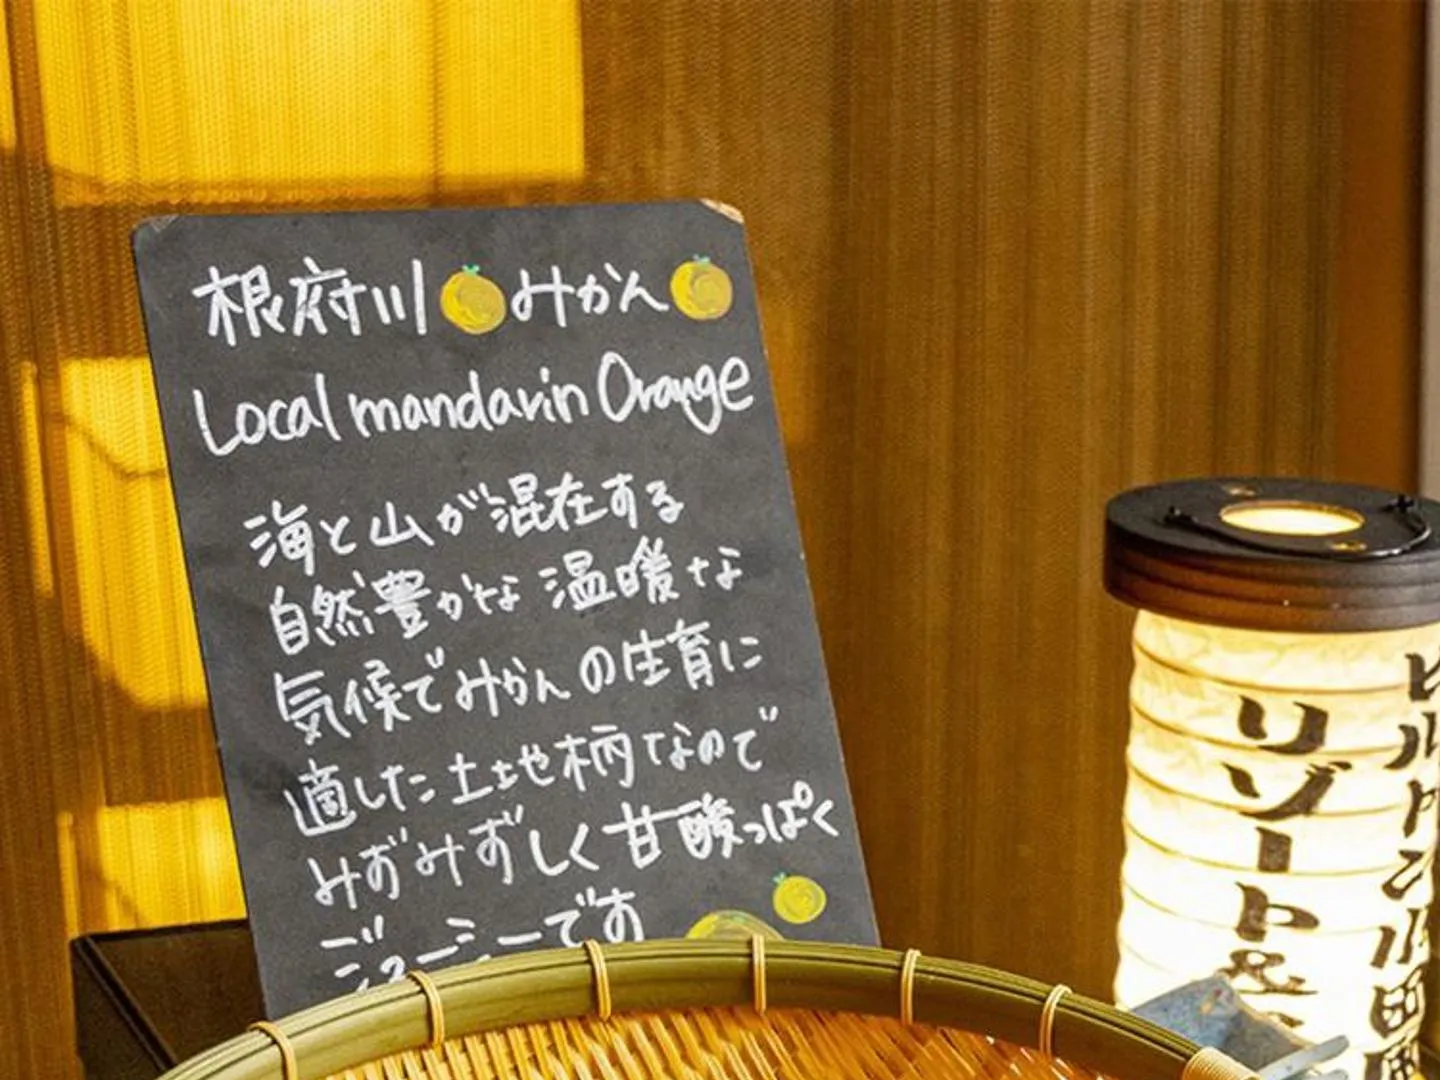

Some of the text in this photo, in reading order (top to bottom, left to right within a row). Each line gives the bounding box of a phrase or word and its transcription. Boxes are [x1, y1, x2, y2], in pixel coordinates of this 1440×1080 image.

[193, 256, 670, 345] 根府川 みかん
[193, 351, 755, 455] Local mandarin Orange
[243, 471, 685, 576] 海と山が混在する
